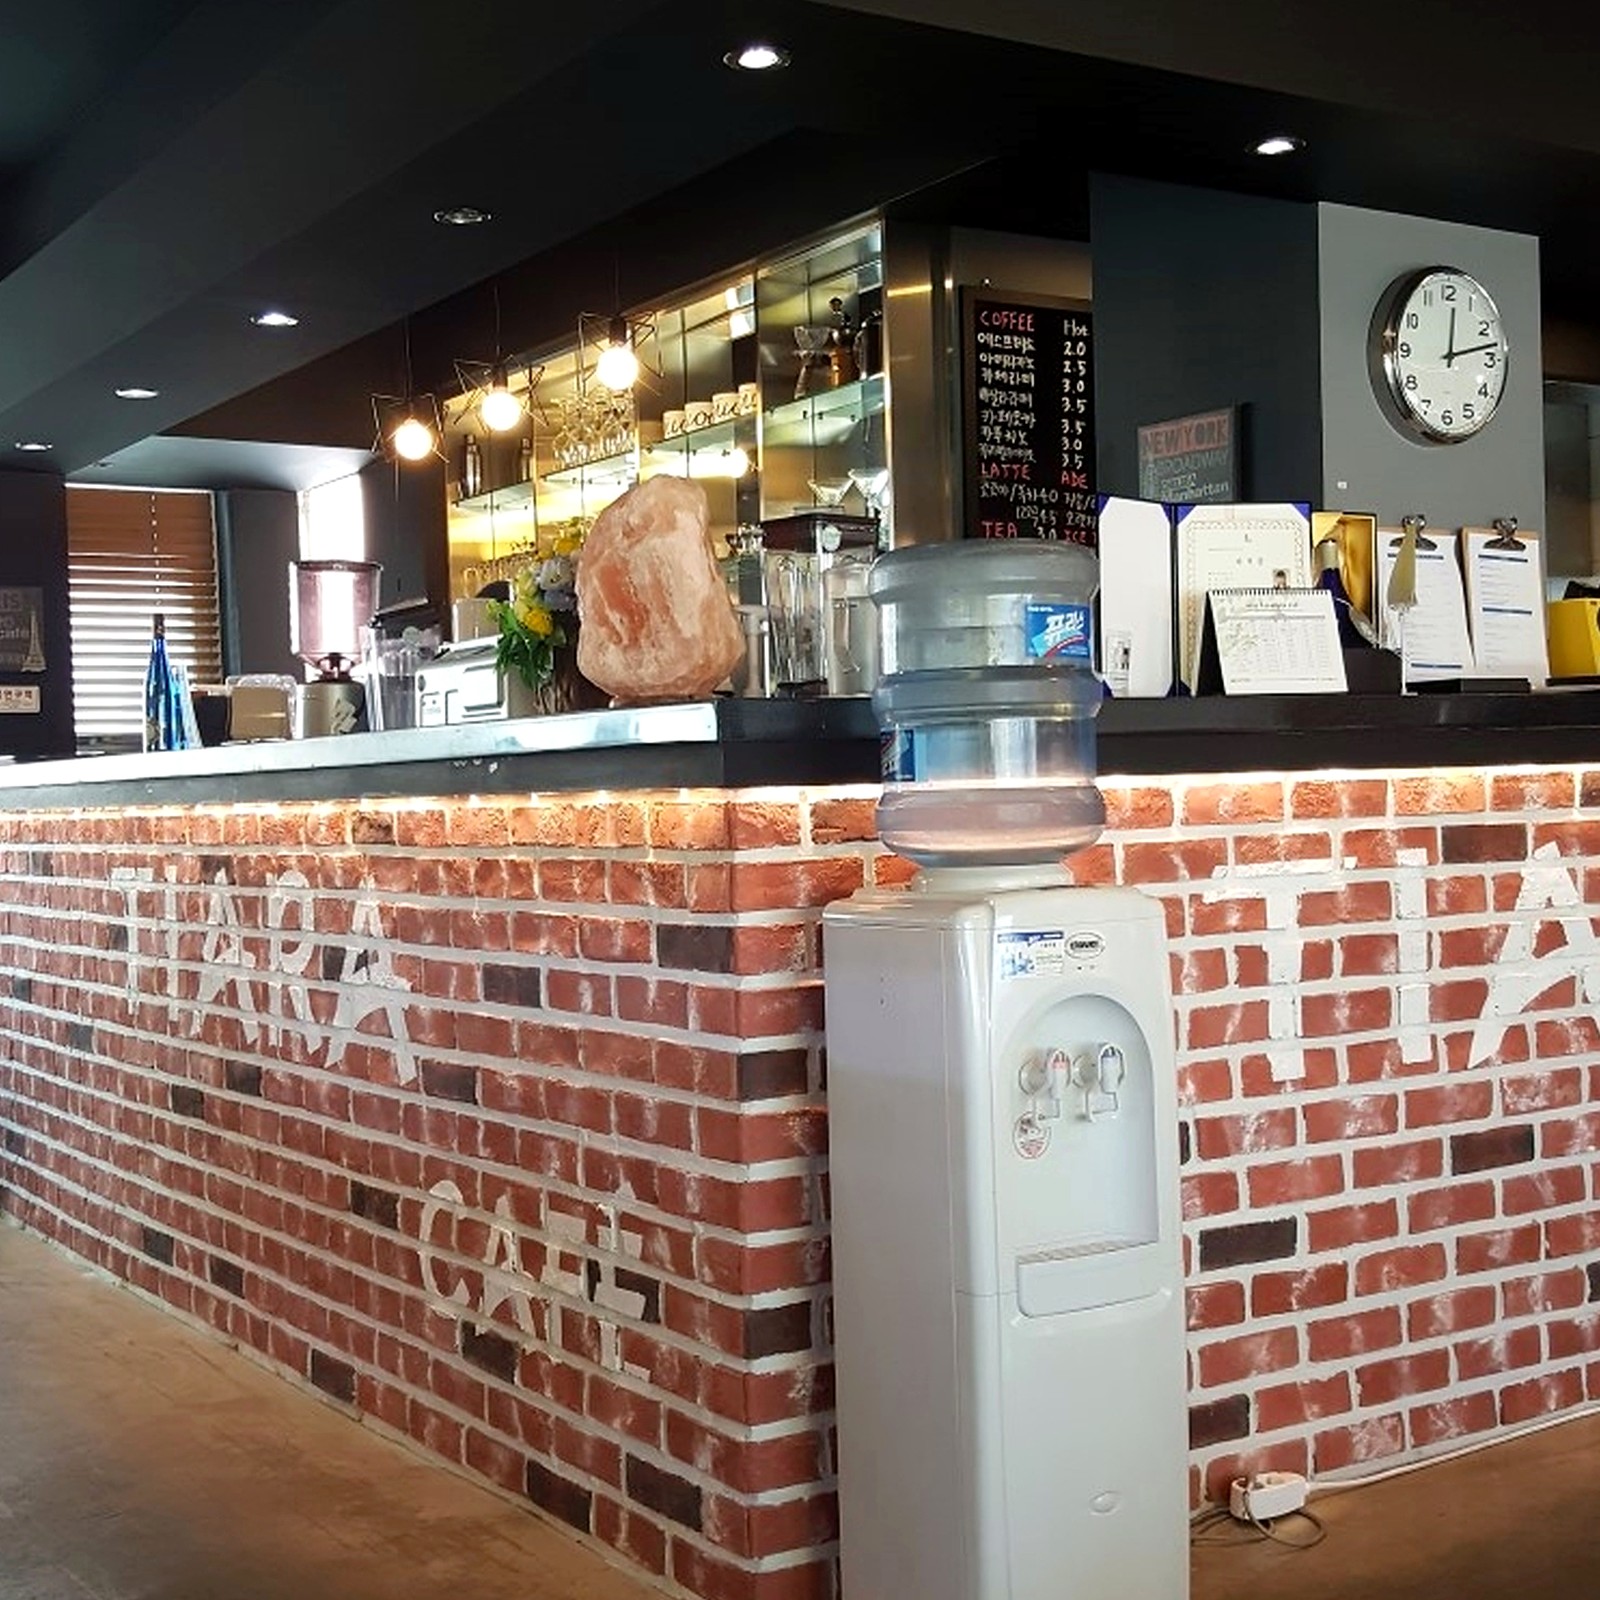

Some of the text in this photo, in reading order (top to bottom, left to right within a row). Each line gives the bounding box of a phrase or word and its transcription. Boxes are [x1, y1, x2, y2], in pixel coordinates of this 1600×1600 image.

[1423, 290, 1434, 306] 11
[1441, 285, 1457, 302] 12
[979, 310, 1091, 338] COFFEE Hot
[1406, 313, 1419, 329] 10
[1478, 321, 1490, 337] 2
[1063, 341, 1087, 357] 2.0
[1400, 342, 1411, 358] 9
[1484, 351, 1496, 368] 3
[1061, 378, 1086, 395] 3.0
[1405, 374, 1418, 390] 8
[1477, 383, 1489, 398] 4
[1061, 396, 1088, 414] 3.5
[1421, 399, 1432, 415] 7
[1462, 403, 1475, 419] 5
[1441, 410, 1453, 425] 6
[1061, 418, 1087, 436] 3.5
[1061, 436, 1083, 452] 3.0
[1061, 453, 1085, 470] 3.5
[980, 462, 1090, 490] LATTE ADE
[981, 520, 1019, 539] TEA
[109, 866, 420, 1086] TIARA
